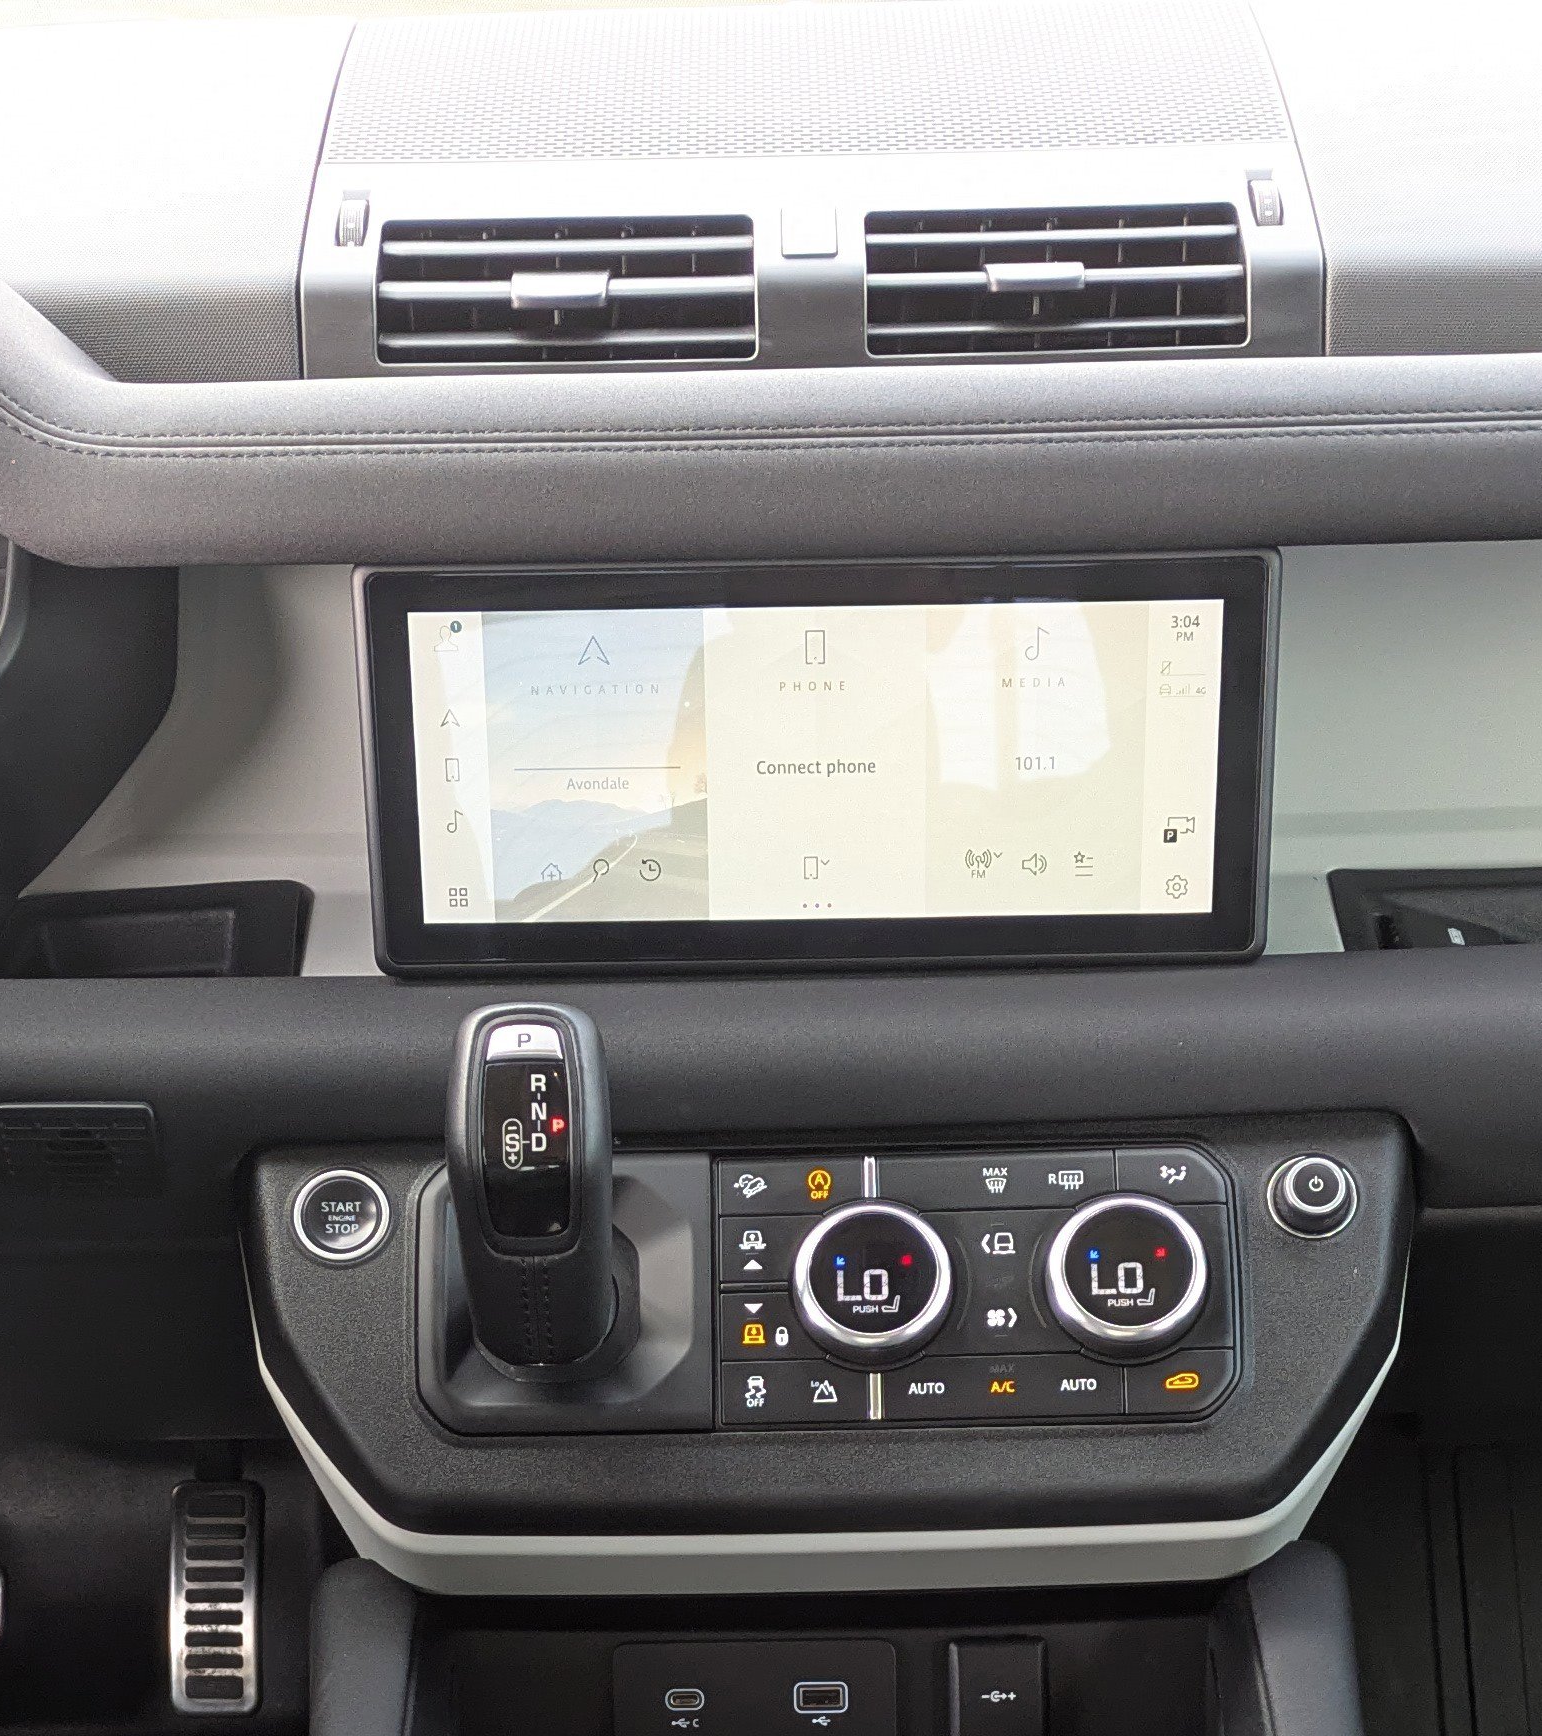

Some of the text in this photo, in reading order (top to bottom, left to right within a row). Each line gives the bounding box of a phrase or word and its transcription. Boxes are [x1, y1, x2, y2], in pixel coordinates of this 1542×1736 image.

[1171, 615, 1200, 628] 3:04
[1176, 631, 1194, 641] PM
[779, 681, 847, 692] PHONE
[1001, 677, 1066, 688] MEDIA
[531, 684, 660, 696] NAVIGATION
[1195, 686, 1207, 695] 4G
[756, 759, 876, 777] Connect phone
[1014, 756, 1056, 770] 101.1
[566, 777, 630, 790] Avondale
[971, 869, 986, 879] FM
[517, 1033, 532, 1048] P
[530, 1073, 547, 1092] R
[531, 1102, 547, 1120] N
[552, 1119, 565, 1132] P
[505, 1133, 520, 1153] S
[531, 1132, 547, 1152] D
[982, 1167, 1008, 1176] MAX
[1048, 1174, 1057, 1184] R
[810, 1190, 829, 1199] OFF
[320, 1201, 361, 1213] START
[327, 1214, 356, 1222] ENGINE
[325, 1223, 359, 1234] STOP
[1107, 1298, 1134, 1307] PUSH
[852, 1304, 879, 1314] PUSH
[908, 1382, 945, 1395] AUTO
[990, 1380, 1016, 1393] A/C
[1061, 1378, 1097, 1391] AUTO
[746, 1398, 765, 1407] OFF
